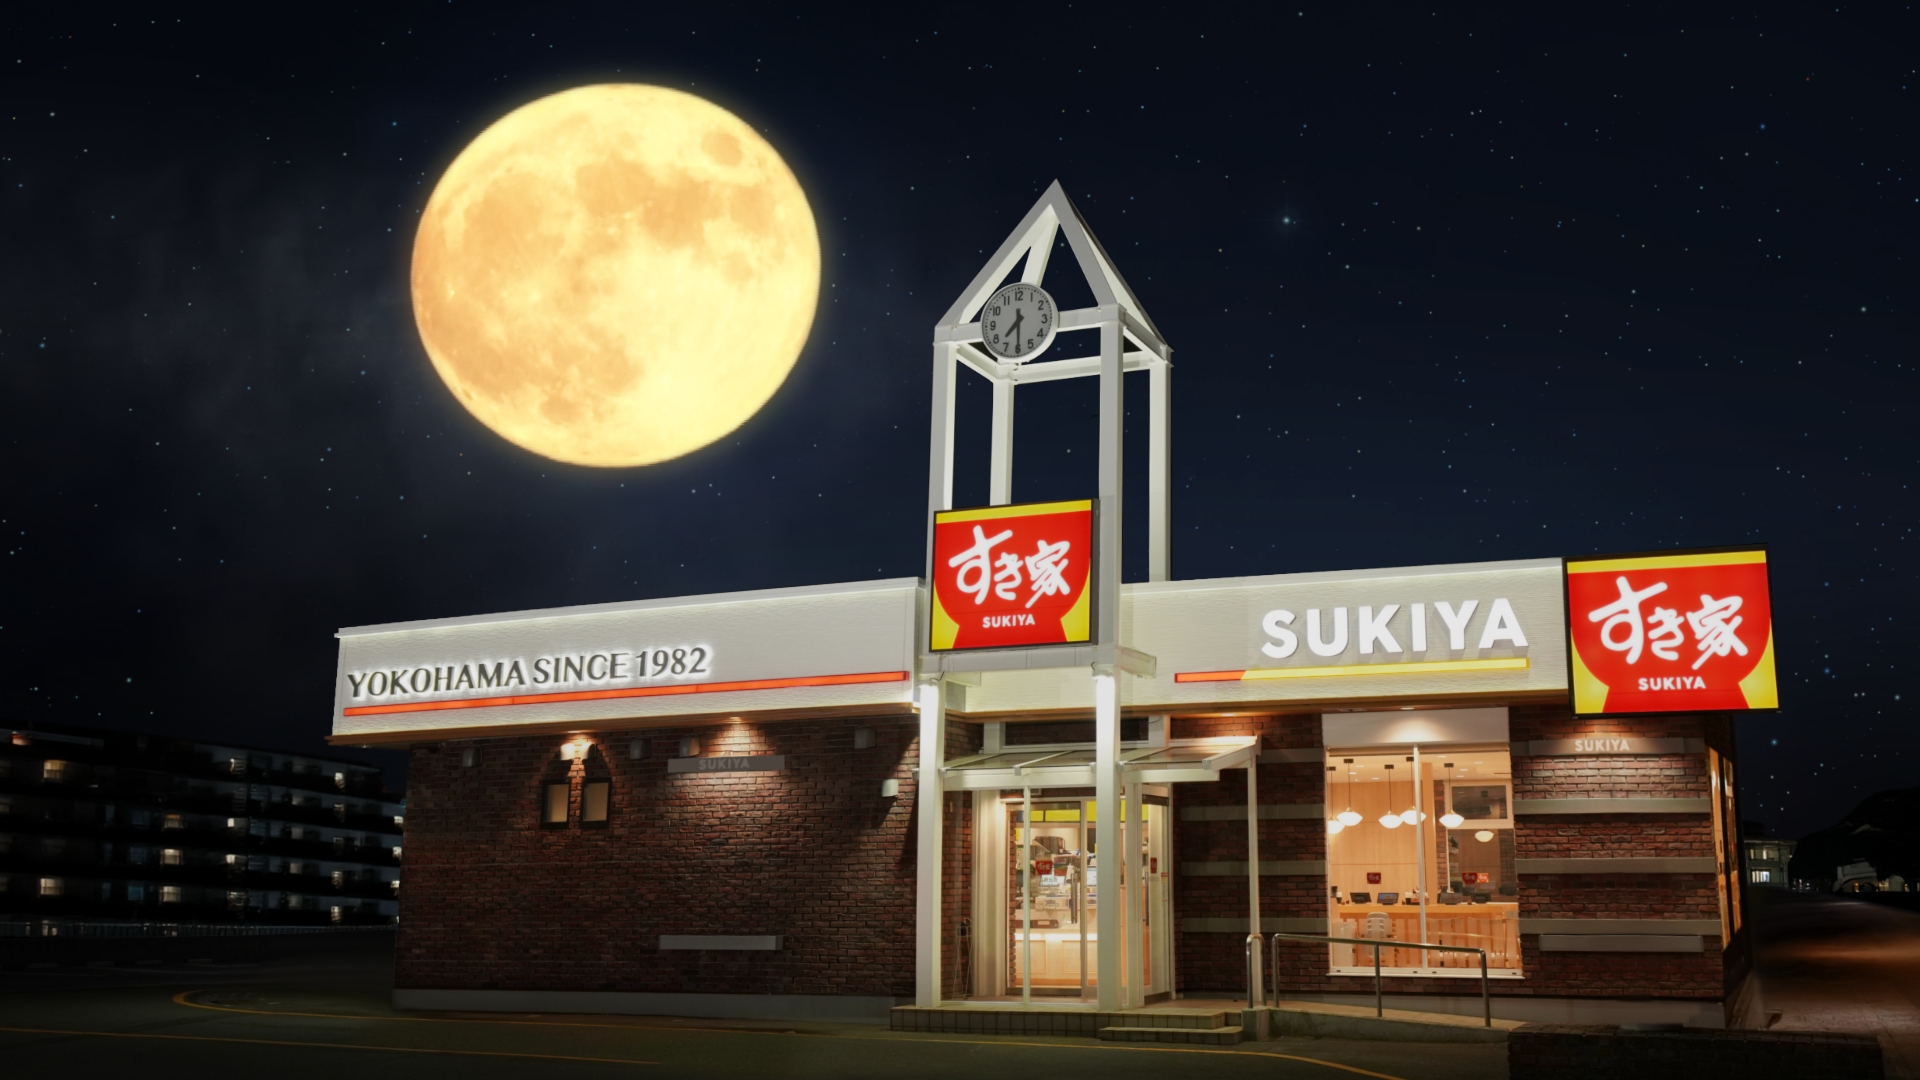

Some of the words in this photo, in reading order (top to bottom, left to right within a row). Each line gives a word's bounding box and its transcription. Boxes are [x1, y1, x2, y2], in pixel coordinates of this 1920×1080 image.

[1003, 295, 1010, 306] 11
[1014, 290, 1024, 302] 12
[1038, 300, 1044, 310] 2
[992, 306, 1001, 317] 10
[1041, 313, 1048, 324] 3
[990, 320, 996, 331] 9
[1036, 328, 1044, 338] 4
[992, 334, 1000, 344] 8
[1027, 338, 1034, 349] 5
[1002, 342, 1010, 353] 7
[1014, 344, 1021, 354] 6
[948, 525, 1071, 609] すき家
[982, 613, 1036, 629] SUKIYA
[1588, 575, 1749, 670] すき家
[1261, 598, 1529, 659] SUKIYA
[347, 660, 527, 698] YOKOHAMA
[533, 652, 630, 684] SINCE
[635, 647, 708, 678] 1982
[1638, 676, 1707, 691] SUKIYA
[1574, 739, 1630, 752] SUKIYA
[698, 758, 751, 770] SUKIYA
